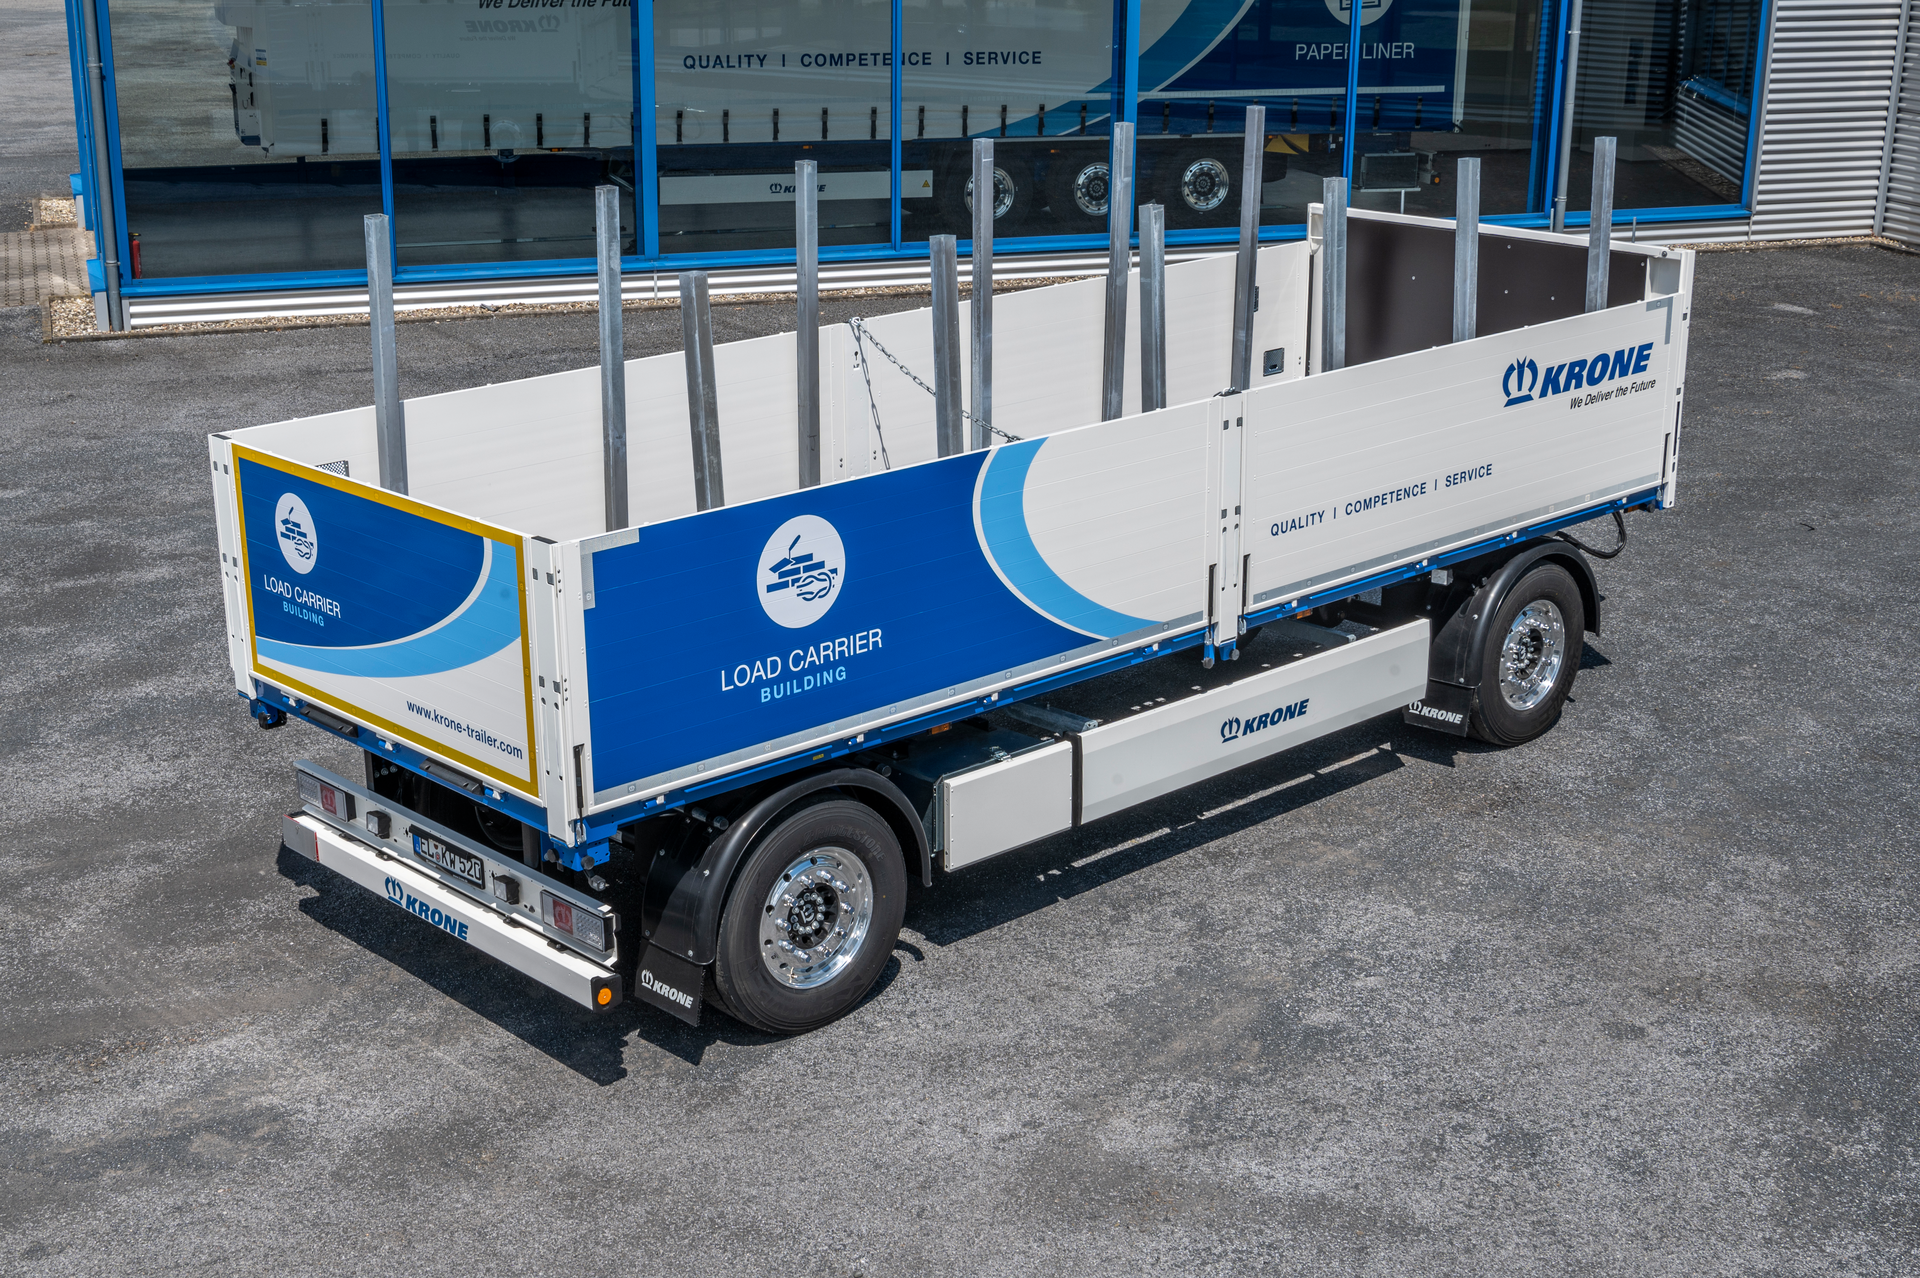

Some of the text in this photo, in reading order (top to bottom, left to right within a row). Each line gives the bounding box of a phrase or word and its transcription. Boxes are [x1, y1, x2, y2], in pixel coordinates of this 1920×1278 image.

[508, 0, 564, 8] Deliver
[683, 53, 768, 70] QUALITY
[963, 51, 1042, 66] SERVICE
[1362, 42, 1415, 59] LINER
[1538, 341, 1654, 399] KRONE
[1570, 379, 1656, 409] We Deliver the Future
[1270, 510, 1325, 537] QUALITY
[1345, 481, 1427, 516] COMPETENCE
[1444, 463, 1493, 488] SERVICE
[264, 574, 341, 619] LOAD CARRIER
[282, 600, 325, 627] BUILDING
[721, 628, 882, 691] LOAD CARRIER
[761, 666, 847, 703] BUILDING
[406, 700, 523, 760] www.krone-trailer.com
[1241, 698, 1310, 736] KRONE
[1421, 706, 1463, 724] KRONE
[405, 893, 469, 941] KRONE
[652, 980, 694, 1009] KRONE
